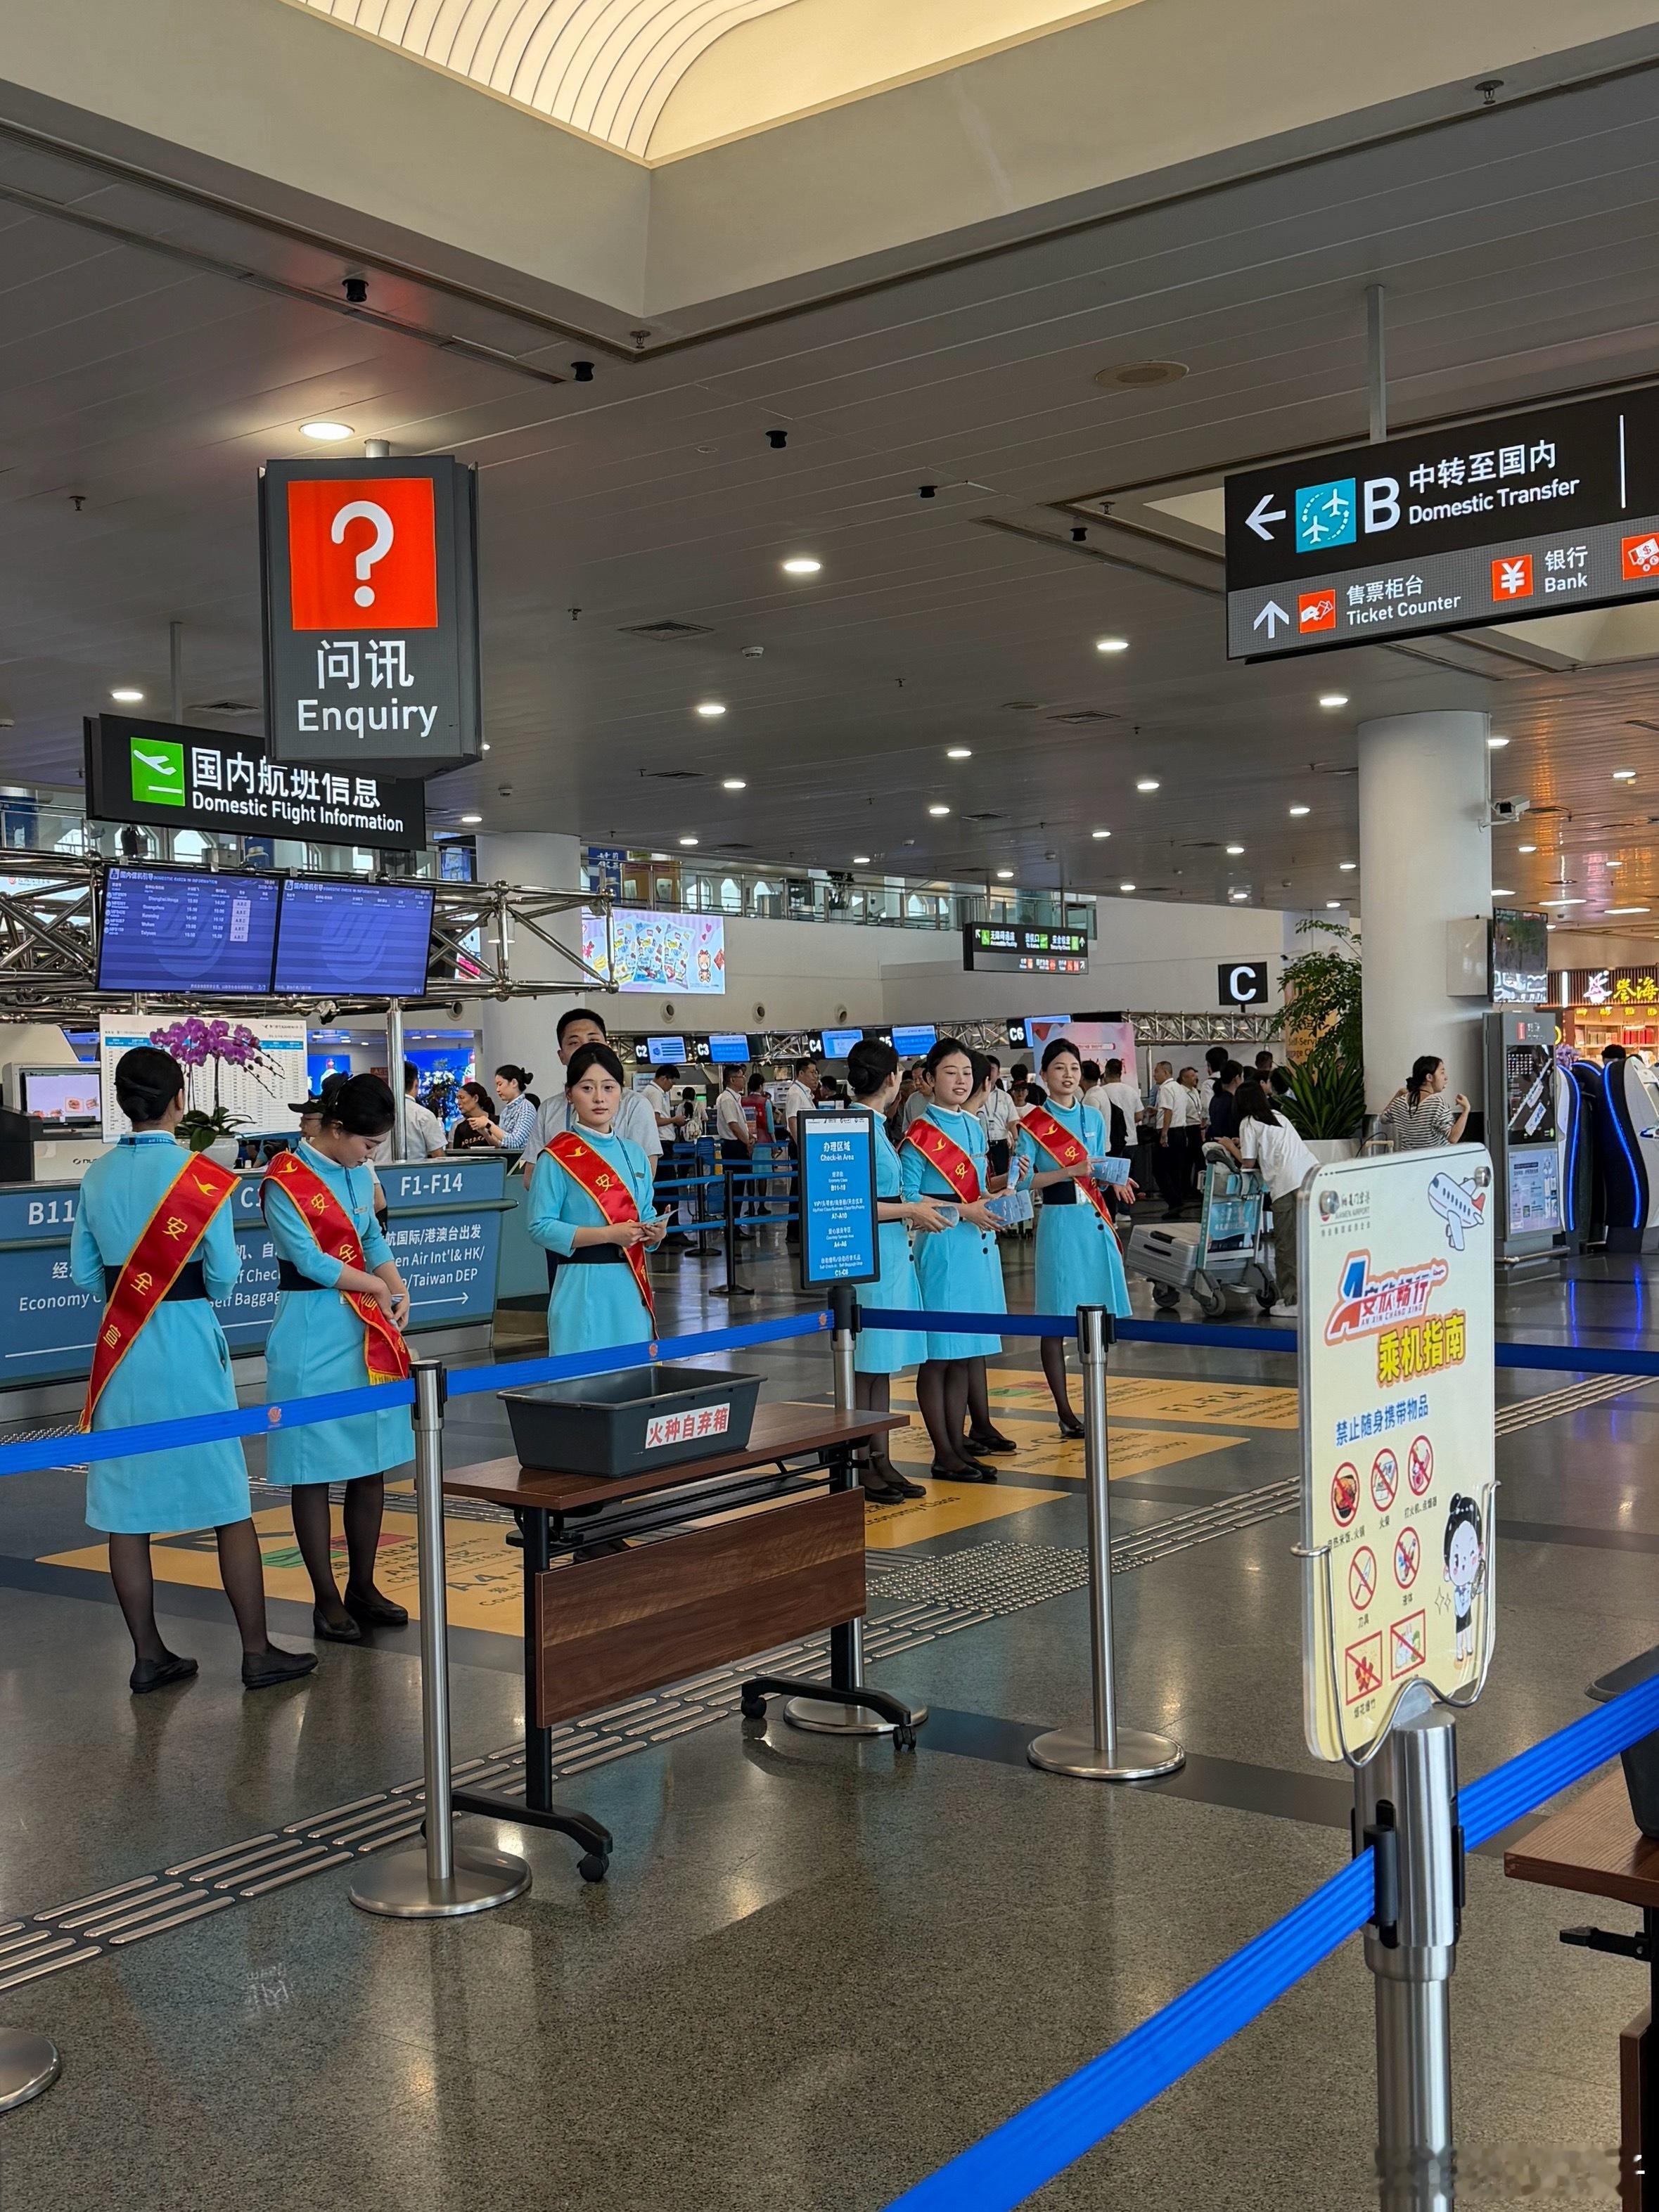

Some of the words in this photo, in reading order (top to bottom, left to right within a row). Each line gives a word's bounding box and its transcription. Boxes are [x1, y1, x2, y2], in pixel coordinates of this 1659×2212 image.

[1409, 440, 1556, 494] 中转至国内
[1364, 477, 1400, 533] B
[1409, 492, 1493, 524] Domestic
[1498, 477, 1580, 508] Transfer
[1545, 546, 1588, 571] 银行
[1347, 574, 1423, 606] 售票柜台
[1545, 573, 1588, 593] Bank
[1347, 605, 1393, 626] Ticket
[1398, 594, 1461, 617] Counter
[317, 639, 414, 690] 问讯
[298, 698, 437, 738] Enquiry
[191, 747, 381, 808] 国内航班信息
[193, 792, 267, 817] Domestic
[272, 802, 316, 825] Flight
[320, 810, 404, 832] Information
[1229, 966, 1256, 1001] C
[809, 1040, 821, 1053] C4
[1009, 1027, 1025, 1041] C6
[636, 1045, 648, 1057] C2
[697, 1043, 710, 1056] C3
[824, 1141, 851, 1152] 办理区域
[401, 1173, 463, 1196] F1-F14
[383, 1224, 482, 1247] 航国际/港澳台出发
[411, 1252, 428, 1266] Air
[464, 1245, 485, 1261] HK/
[456, 1268, 478, 1282] DEP
[19, 1293, 89, 1311] Economy
[1378, 1312, 1466, 1382] 乘机指南
[1158, 1391, 1254, 1413] F1-F14
[648, 1408, 728, 1446] 火种自弃箱
[1336, 1394, 1429, 1446] 禁止随身携带物品
